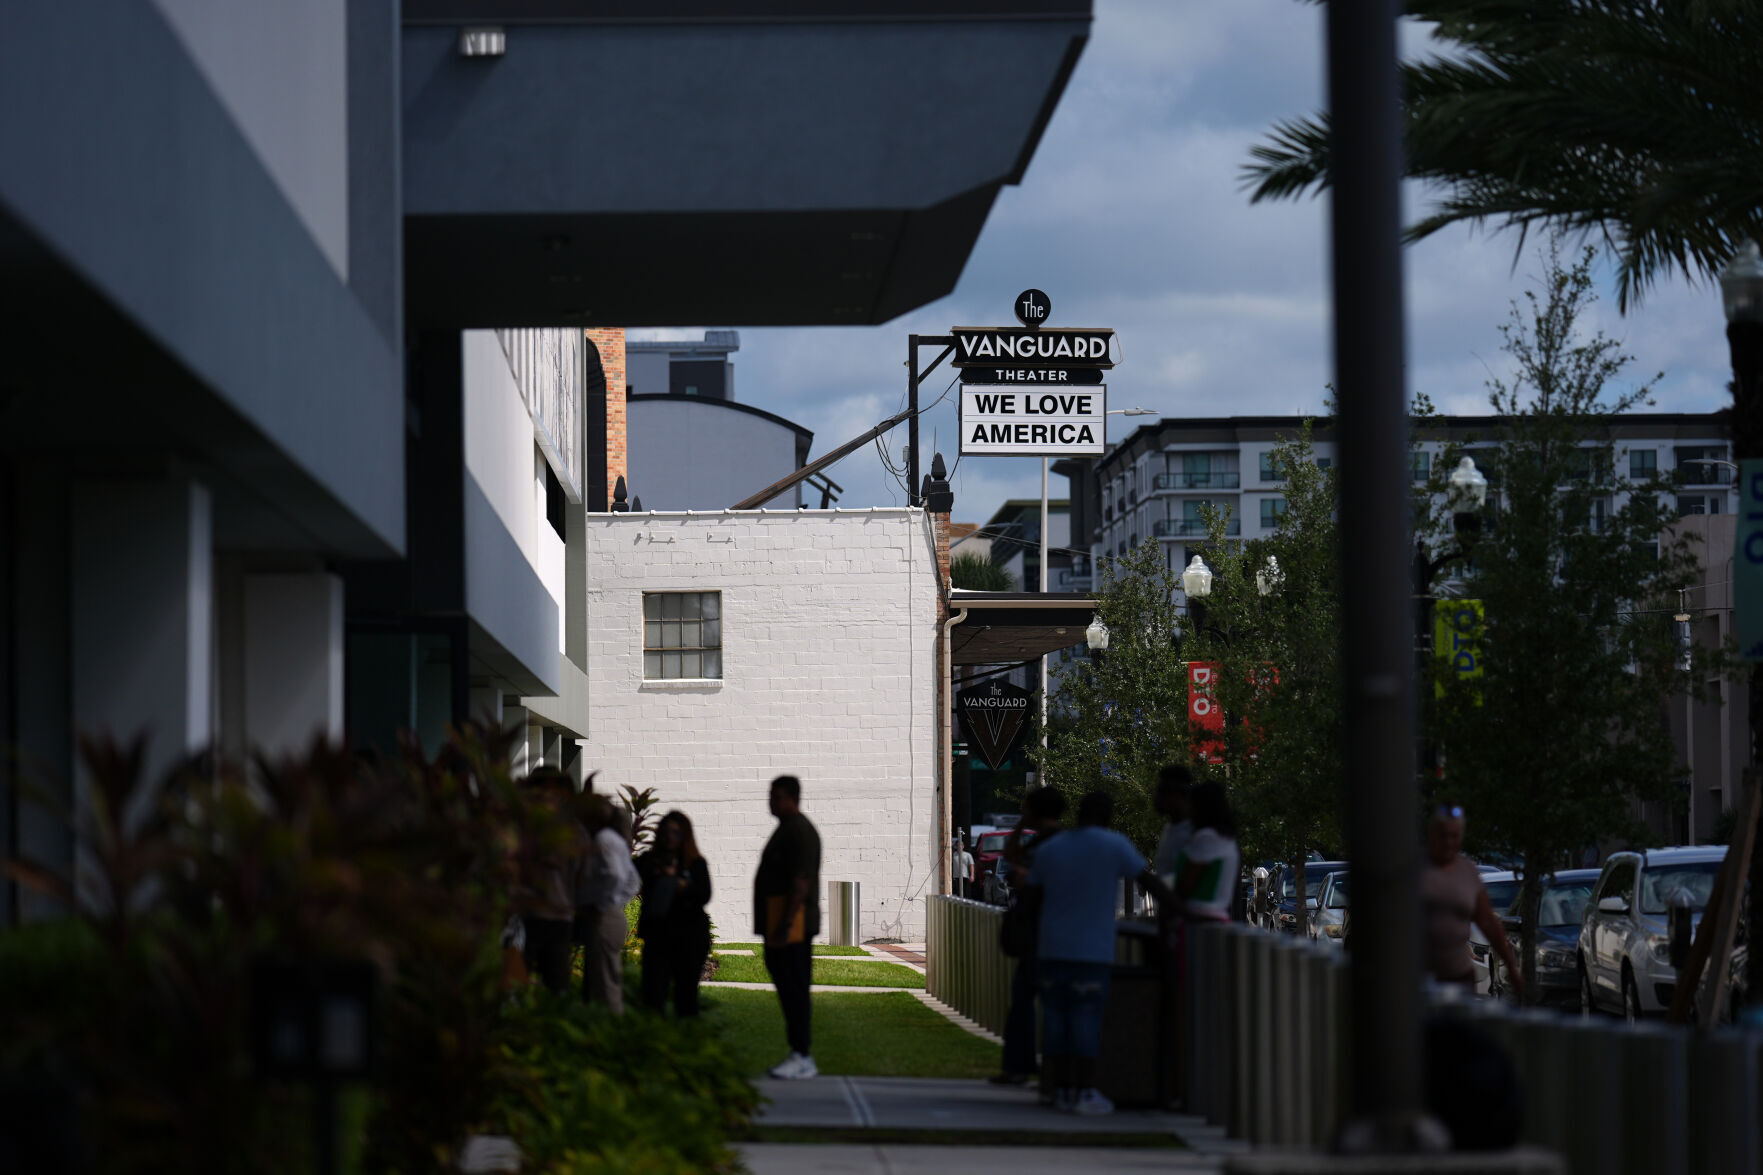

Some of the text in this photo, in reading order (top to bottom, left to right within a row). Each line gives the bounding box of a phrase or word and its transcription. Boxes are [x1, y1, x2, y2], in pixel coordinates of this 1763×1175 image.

[1022, 292, 1044, 318] The
[960, 334, 1107, 359] VANGUARD
[995, 369, 1068, 381] THEATER
[974, 394, 1092, 415] WE LOVE
[970, 424, 1095, 444] AMERICA
[1453, 609, 1475, 672] DTO
[990, 681, 1002, 696] The
[963, 696, 1027, 708] VANGUARD
